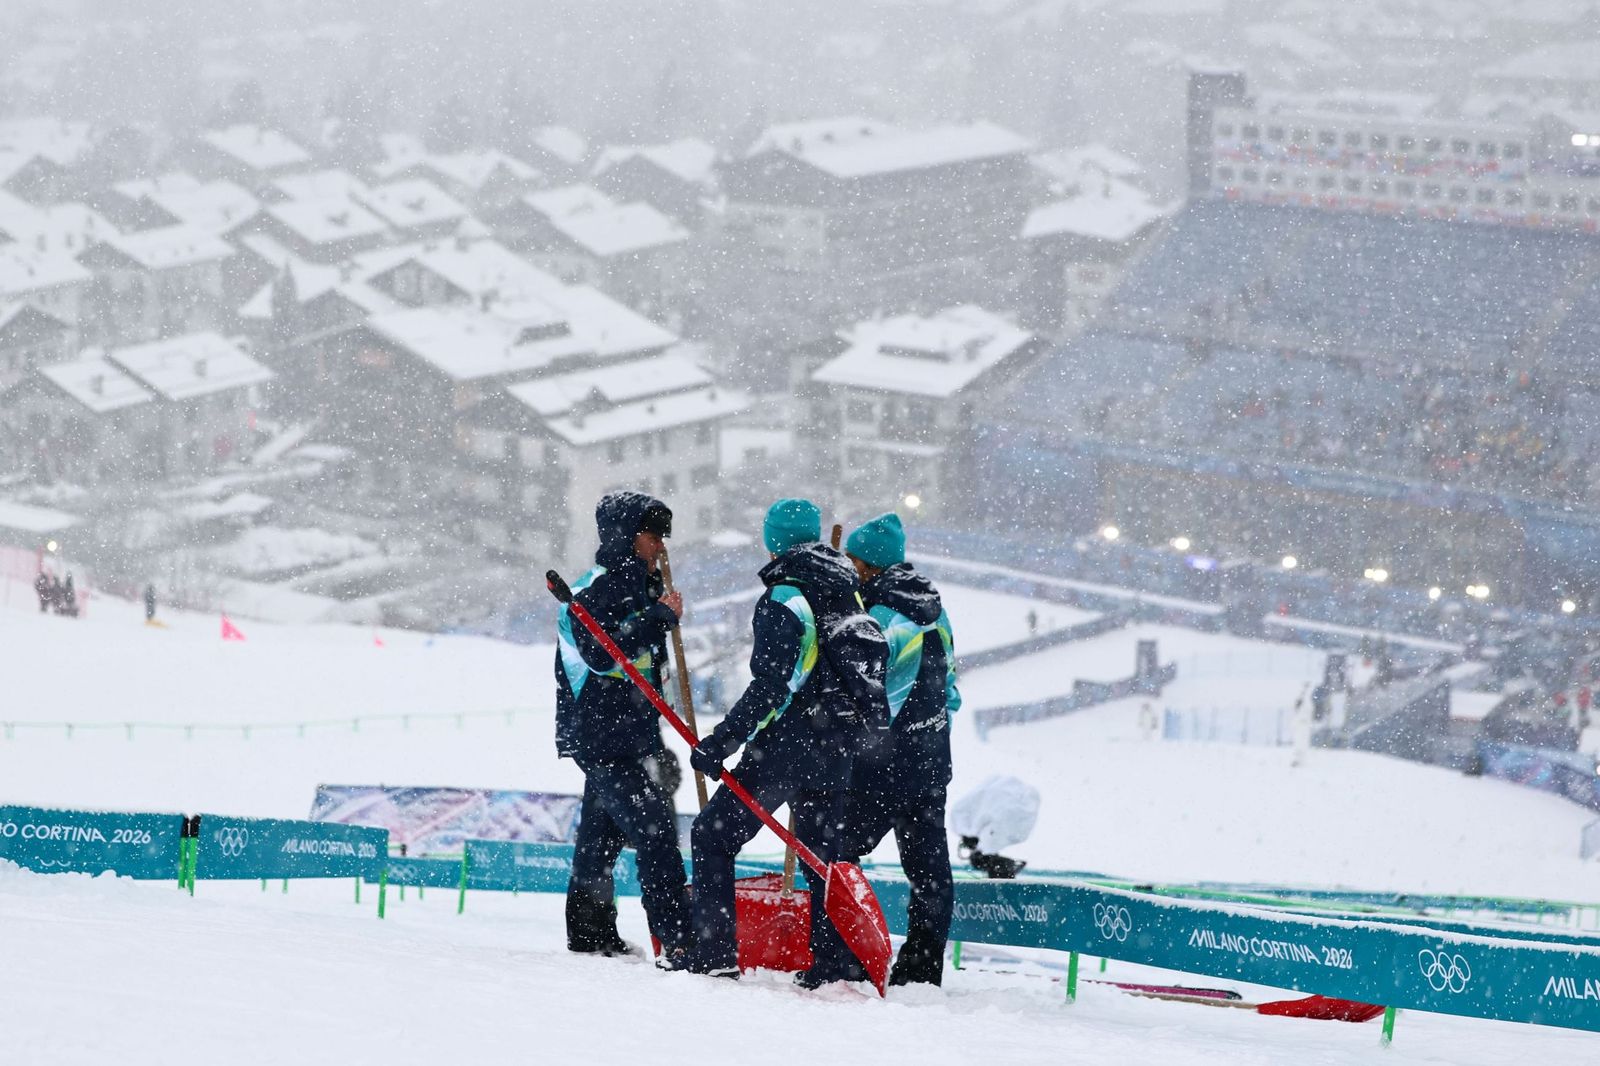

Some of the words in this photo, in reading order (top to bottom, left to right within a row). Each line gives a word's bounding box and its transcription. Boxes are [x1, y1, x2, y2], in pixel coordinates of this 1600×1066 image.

[0, 822, 17, 838] O
[21, 824, 107, 843] CORTINA
[111, 828, 152, 844] 2026
[281, 838, 319, 854] MILANO
[319, 839, 356, 857] CORTINA
[967, 903, 1022, 921] CORTINA
[1021, 904, 1048, 922] 2026
[1188, 928, 1249, 955] MILANO
[1250, 937, 1321, 965] CORTINA
[1322, 945, 1353, 970] 2026
